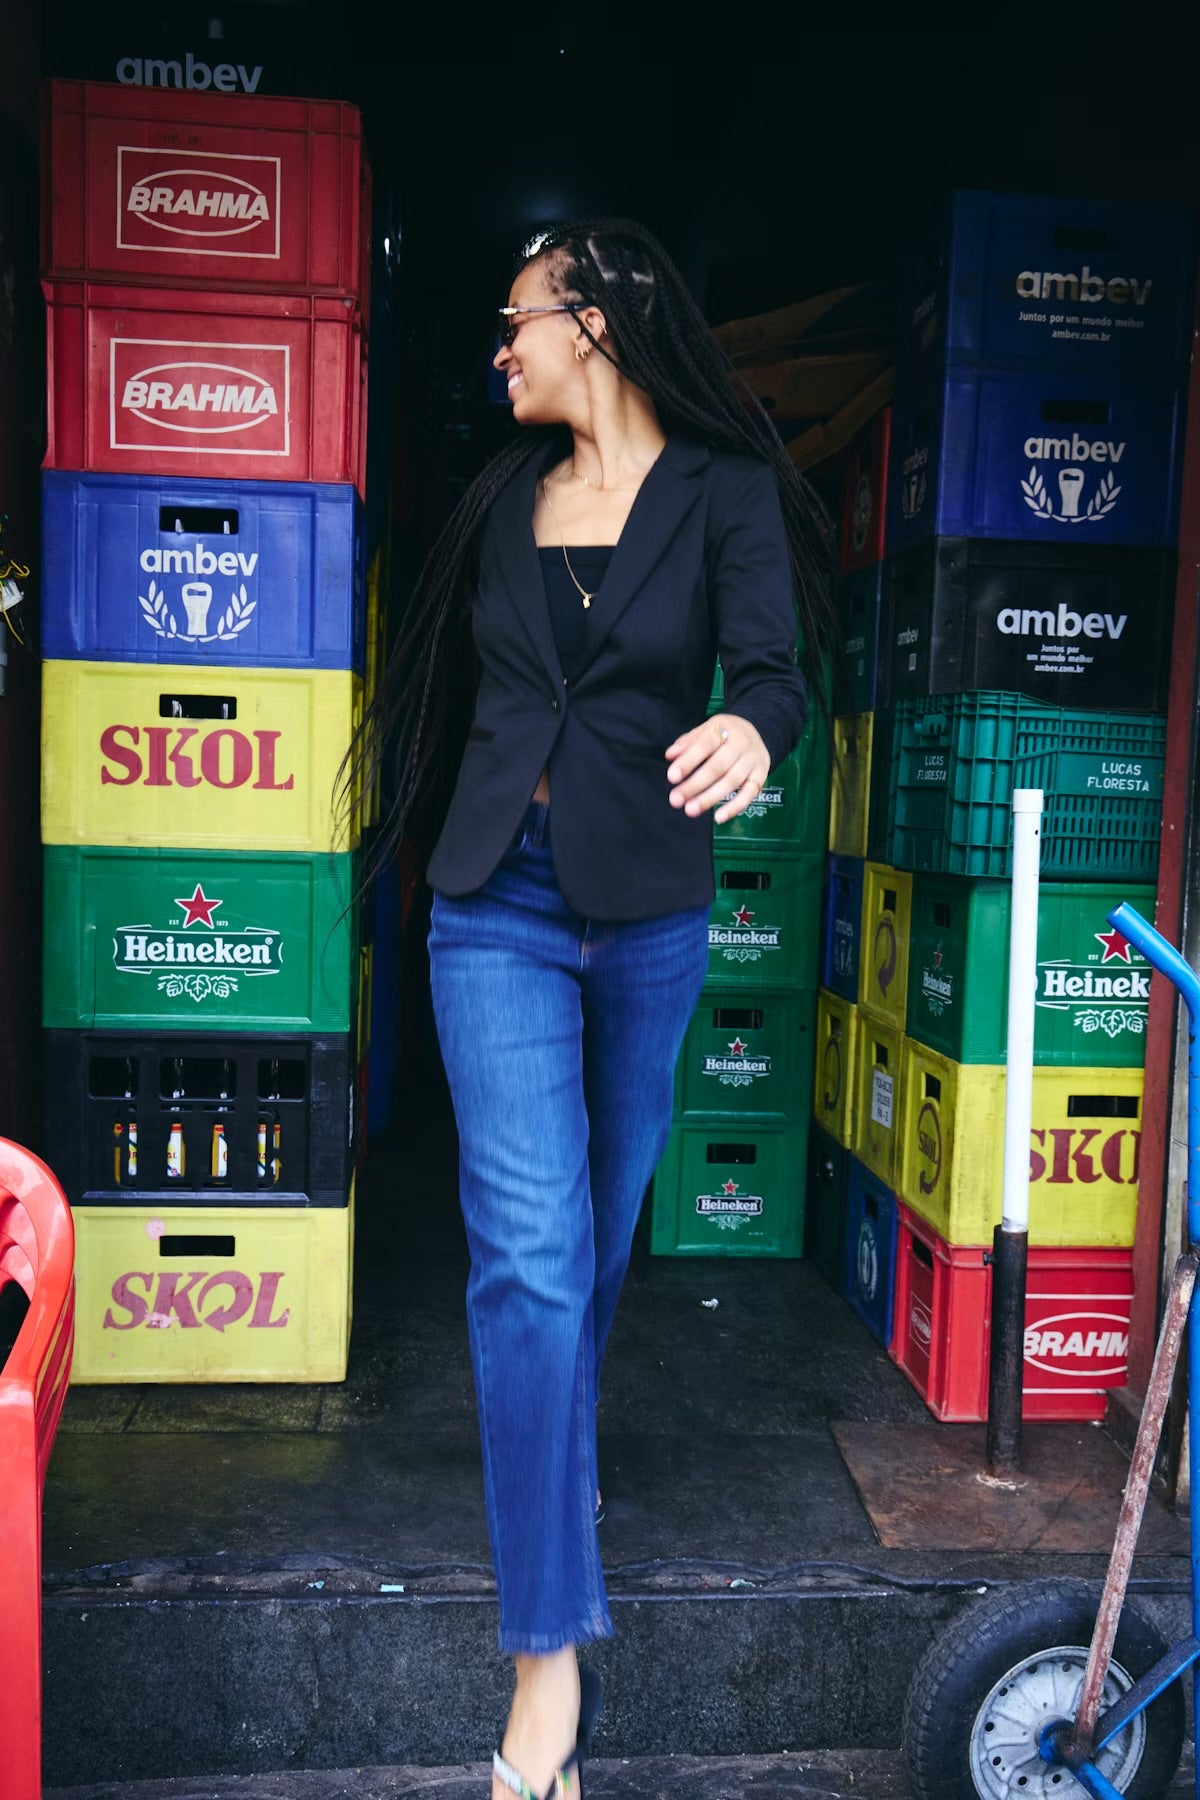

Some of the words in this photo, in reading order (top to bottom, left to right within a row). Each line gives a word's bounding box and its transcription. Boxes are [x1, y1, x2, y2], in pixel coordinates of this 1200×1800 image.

[116, 52, 264, 93] ambev
[127, 185, 270, 221] BRAHMA
[1016, 265, 1153, 306] ambev
[1019, 311, 1047, 322] Juntos
[1049, 314, 1064, 325] por
[1051, 328, 1111, 342] ambev.com.br
[121, 380, 278, 415] BRAHMA
[1023, 433, 1127, 464] ambev
[139, 543, 259, 577] ambev
[997, 603, 1129, 640] ambev
[100, 724, 294, 791] SKOL
[924, 755, 944, 767] LUCAS
[1102, 762, 1142, 776] LUCAS
[917, 769, 947, 782] FLORESTA
[1087, 776, 1150, 792] FLORESTA
[124, 935, 273, 965] Heineken
[1043, 970, 1150, 998] Heinek
[705, 1057, 768, 1072] Heineken
[701, 1199, 759, 1211] Heineken
[102, 1271, 290, 1333] SKOL
